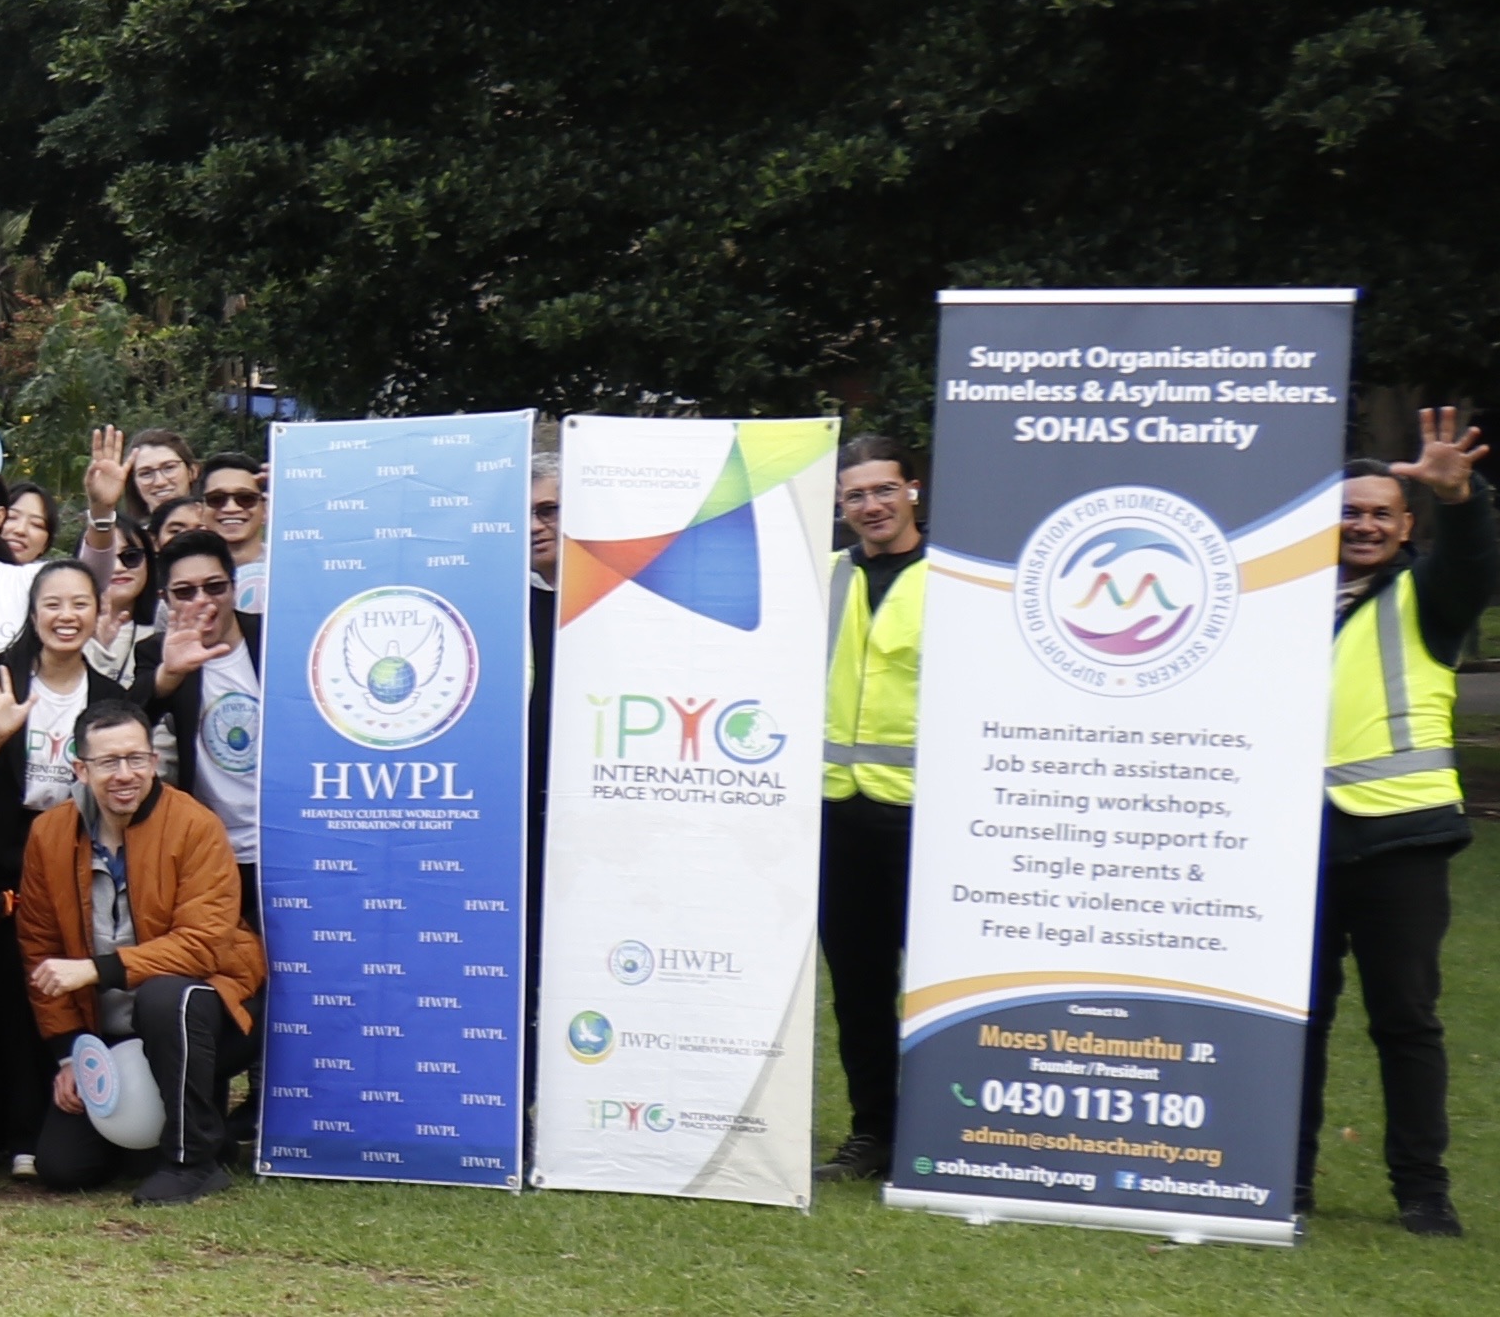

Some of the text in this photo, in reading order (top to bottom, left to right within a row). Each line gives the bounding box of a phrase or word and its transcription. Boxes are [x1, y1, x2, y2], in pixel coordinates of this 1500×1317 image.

[970, 345, 1315, 373] Support Organisation for
[946, 379, 1336, 407] Homeless & Asylum Seekers.
[329, 434, 474, 451] HWPL HWPL
[1014, 416, 1258, 450] SOHAS Charity
[285, 457, 516, 480] HWPL HWPL HWPL
[1024, 494, 1233, 688] SUPPORT ORGANISATION FOR HOMELESS AND ASYLUM SEEKERS
[362, 609, 426, 628] HWPL
[983, 720, 1253, 750] Humanitarian services,
[309, 762, 474, 800] HWPL
[593, 764, 787, 788] INTERNATIONAL
[984, 754, 1241, 784] Job search assistance,
[593, 785, 786, 807] PEACE YOUTH GROUP
[995, 787, 1232, 816] Training workshops,
[302, 809, 480, 819] HEAVENLY CULTURE WORLD PEACE
[327, 820, 453, 830] RESTORATION OF LIGHT
[970, 819, 1248, 851] Counselling support for
[313, 859, 464, 872] HWPL HWPL
[1013, 855, 1206, 883] Single parents &
[363, 898, 509, 912] HWPL HWPL
[952, 884, 1264, 921] Domestic violence victims,
[981, 920, 1228, 952] Free legal assistance.
[658, 948, 743, 974] HWPL
[1068, 1004, 1129, 1019] Contact Us
[621, 1031, 785, 1050] IWPG INTERNATIONAL
[723, 1046, 752, 1056] PEACE
[754, 1049, 785, 1058] GROUP
[979, 1024, 1218, 1064] Moses Vedamuthu JP.
[1030, 1057, 1086, 1077] Founder
[1095, 1062, 1160, 1081] President
[981, 1079, 1205, 1129] 0430 113 180
[680, 1112, 768, 1126] INTERNATIONAL
[680, 1121, 706, 1130] PEACE
[736, 1124, 768, 1134] GROUP
[362, 1150, 405, 1164] HWPL
[961, 1126, 1223, 1168] admin@sohascharity.org
[935, 1158, 1097, 1192] sohascharity.org
[1139, 1175, 1270, 1206] sohascharity
